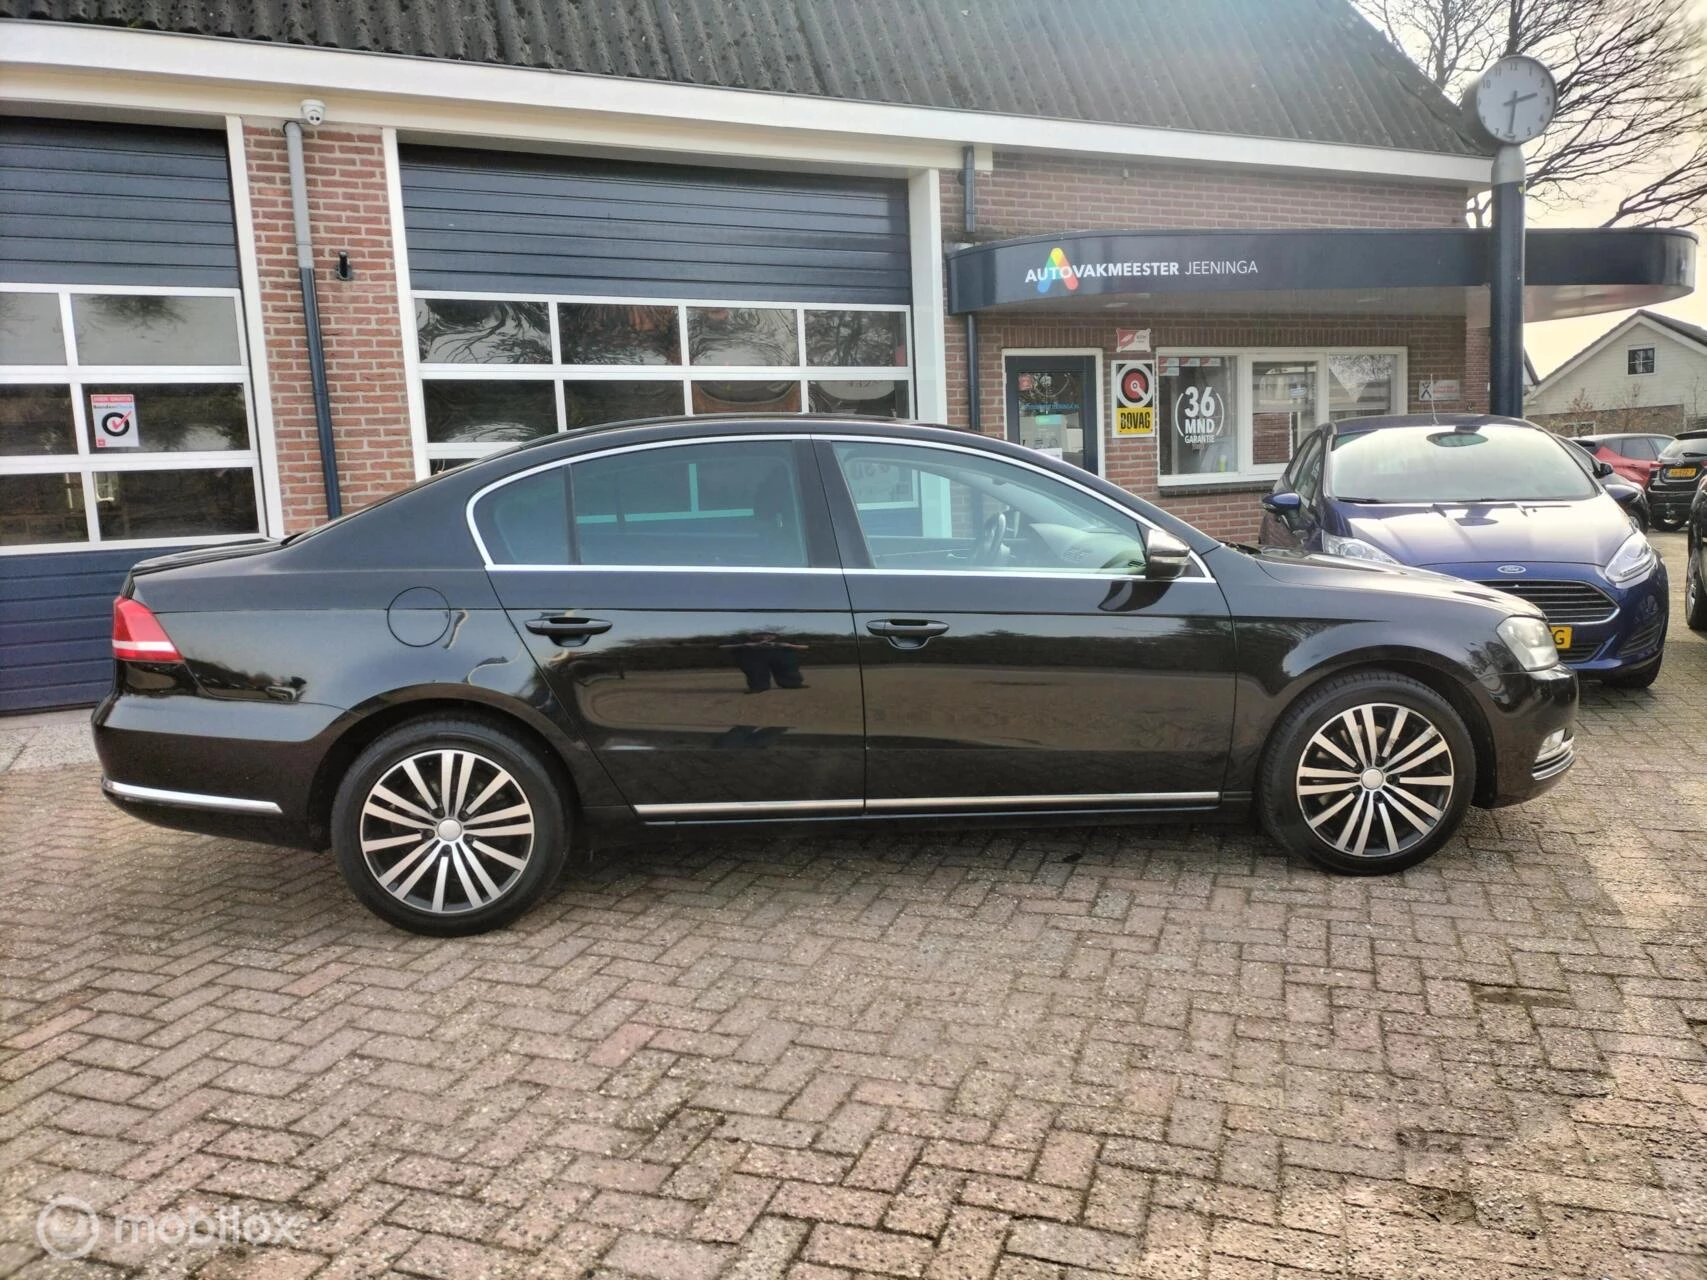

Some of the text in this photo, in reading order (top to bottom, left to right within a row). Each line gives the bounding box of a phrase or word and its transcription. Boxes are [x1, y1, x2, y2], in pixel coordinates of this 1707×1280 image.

[1025, 260, 1259, 283] AUTOVAKMEESTER JEENINGA
[1184, 386, 1216, 418] 36
[1120, 411, 1151, 430] BOVAG
[1184, 419, 1215, 434] MND
[1184, 434, 1215, 444] GARANTIE
